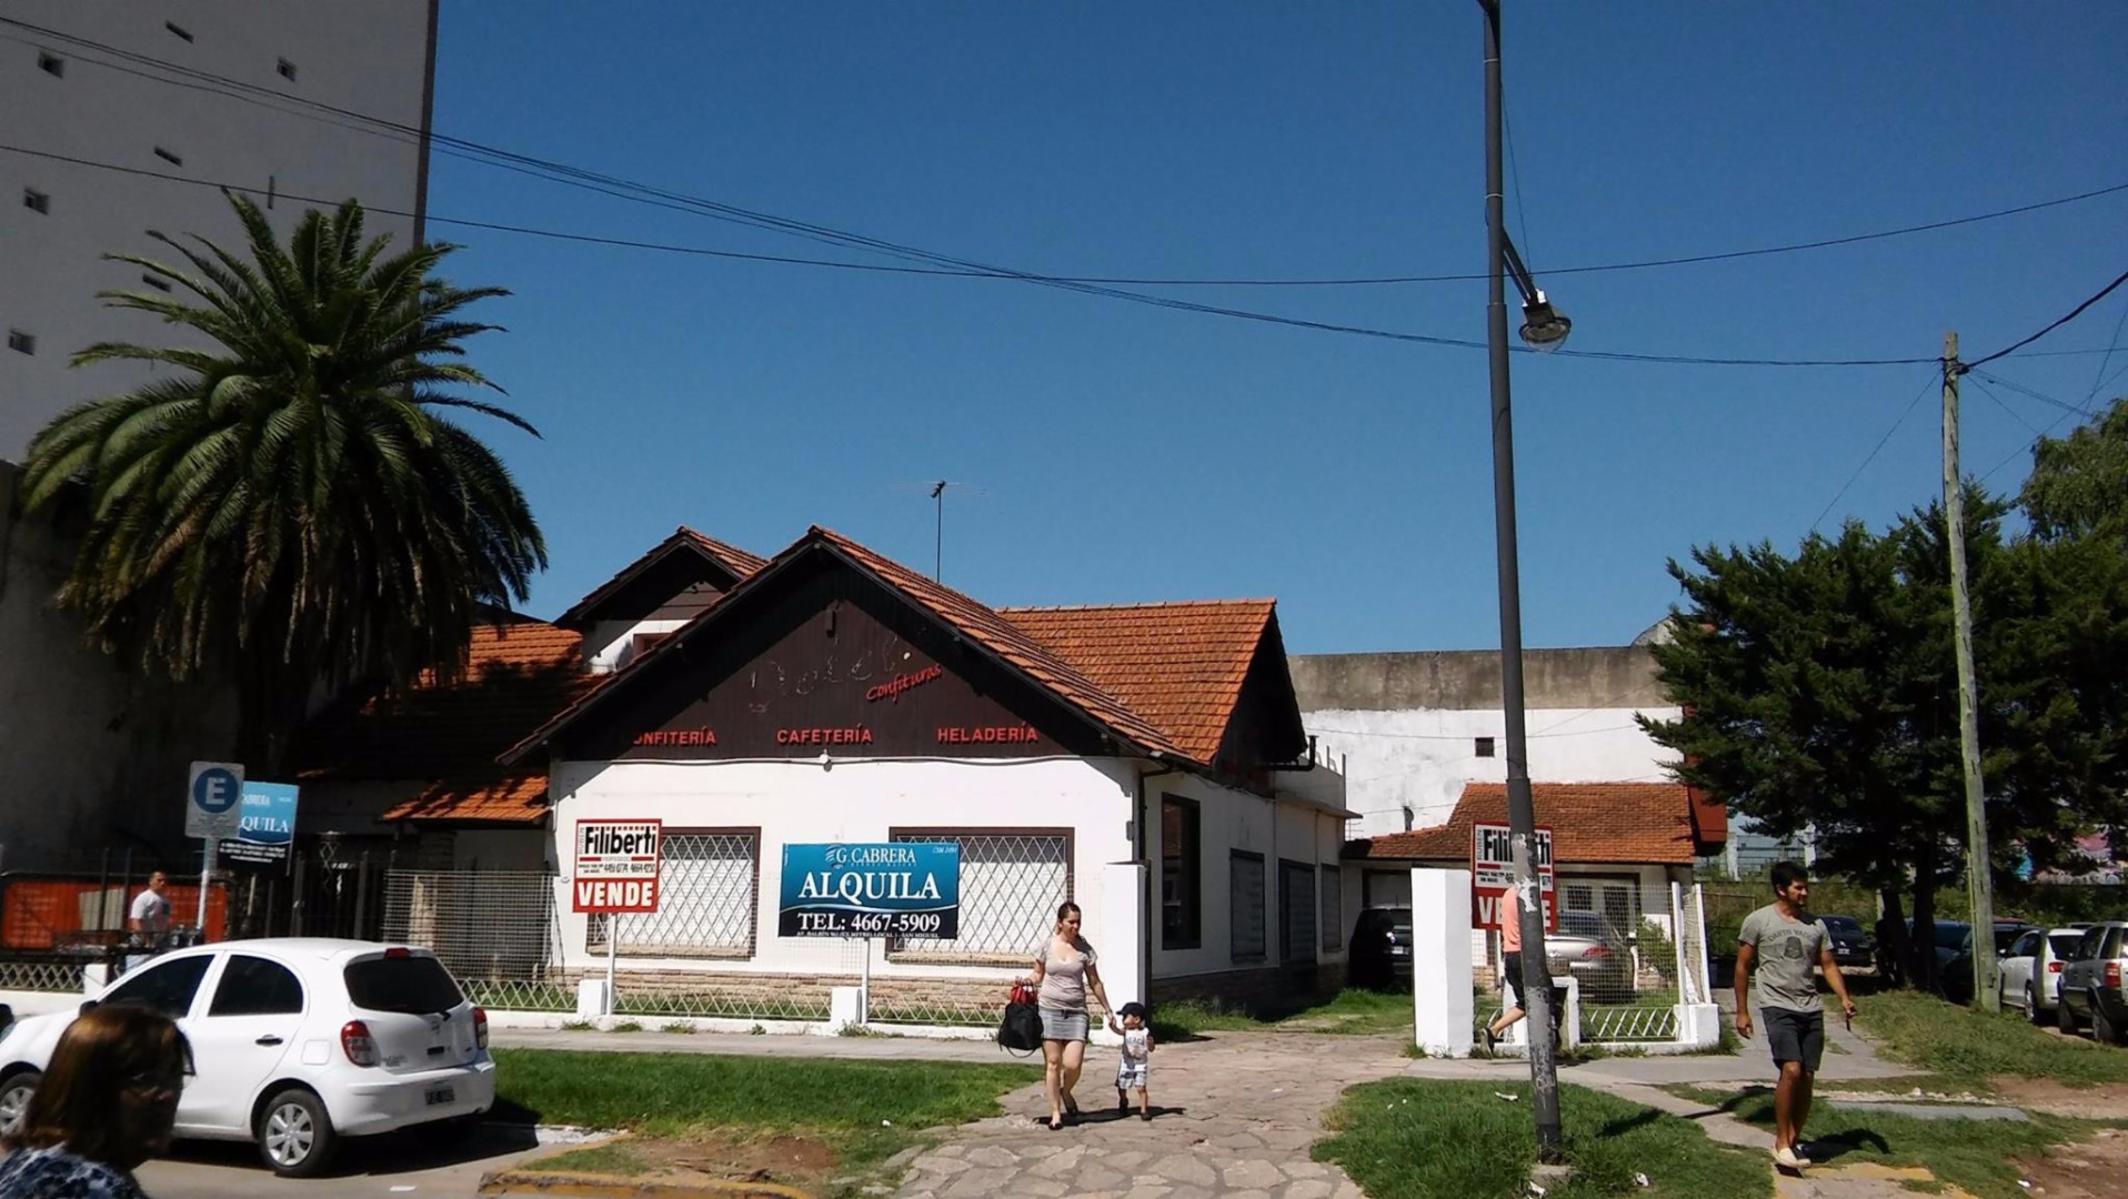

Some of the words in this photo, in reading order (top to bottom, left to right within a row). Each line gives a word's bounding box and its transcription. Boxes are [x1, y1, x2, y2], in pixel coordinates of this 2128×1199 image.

[777, 723, 872, 744] CAFETERÍA
[937, 721, 1038, 742] HELADERÍA
[205, 777, 226, 805] E
[241, 815, 289, 833] QUILA
[585, 825, 656, 854] Filiberti
[1483, 829, 1551, 865] Filiti
[851, 847, 916, 864] CABRERA
[577, 881, 653, 907] VENDE
[798, 872, 941, 905] ALQUILA
[797, 912, 846, 931] TEL:
[851, 914, 940, 932] 4667-5909
[1478, 896, 1551, 927] VEE
